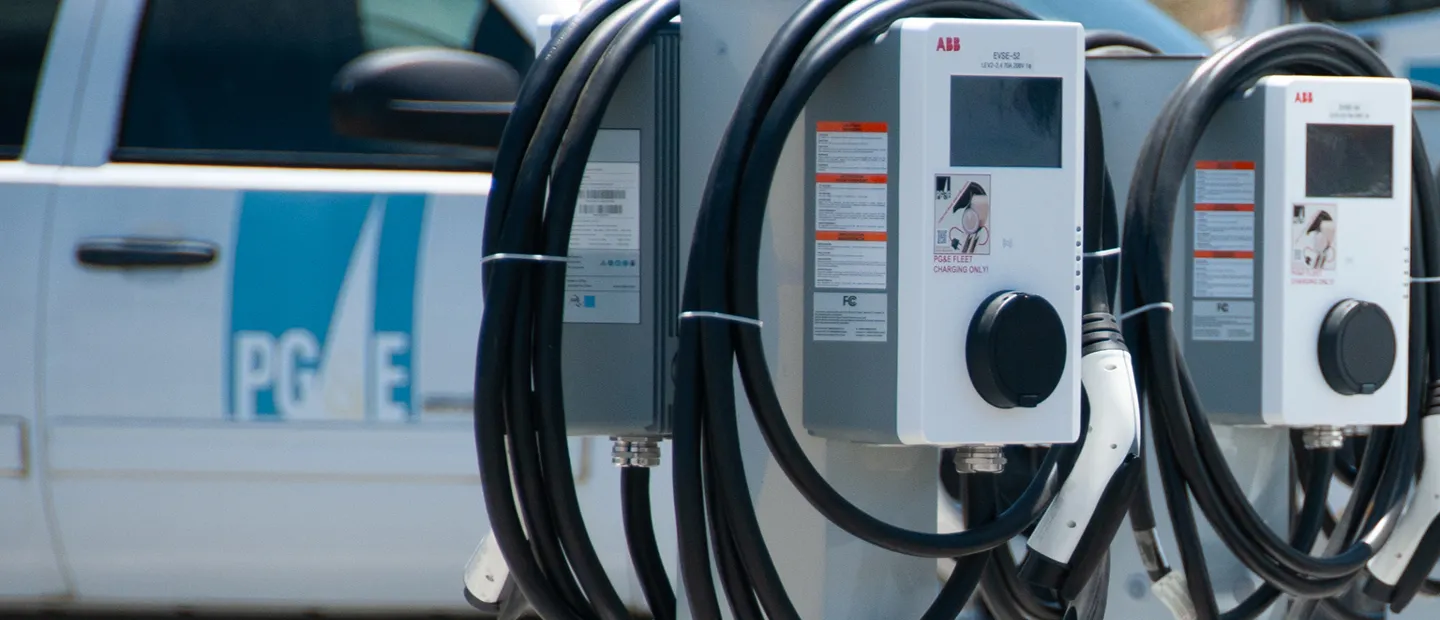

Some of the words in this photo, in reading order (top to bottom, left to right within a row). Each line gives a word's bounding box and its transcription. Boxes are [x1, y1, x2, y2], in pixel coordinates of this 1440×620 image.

[936, 36, 961, 52] ABB
[1294, 91, 1313, 104] ABB
[933, 255, 952, 263] PG&E
[953, 255, 973, 263] FLEET
[933, 265, 968, 274] CHARGING
[233, 328, 409, 420] PGE
